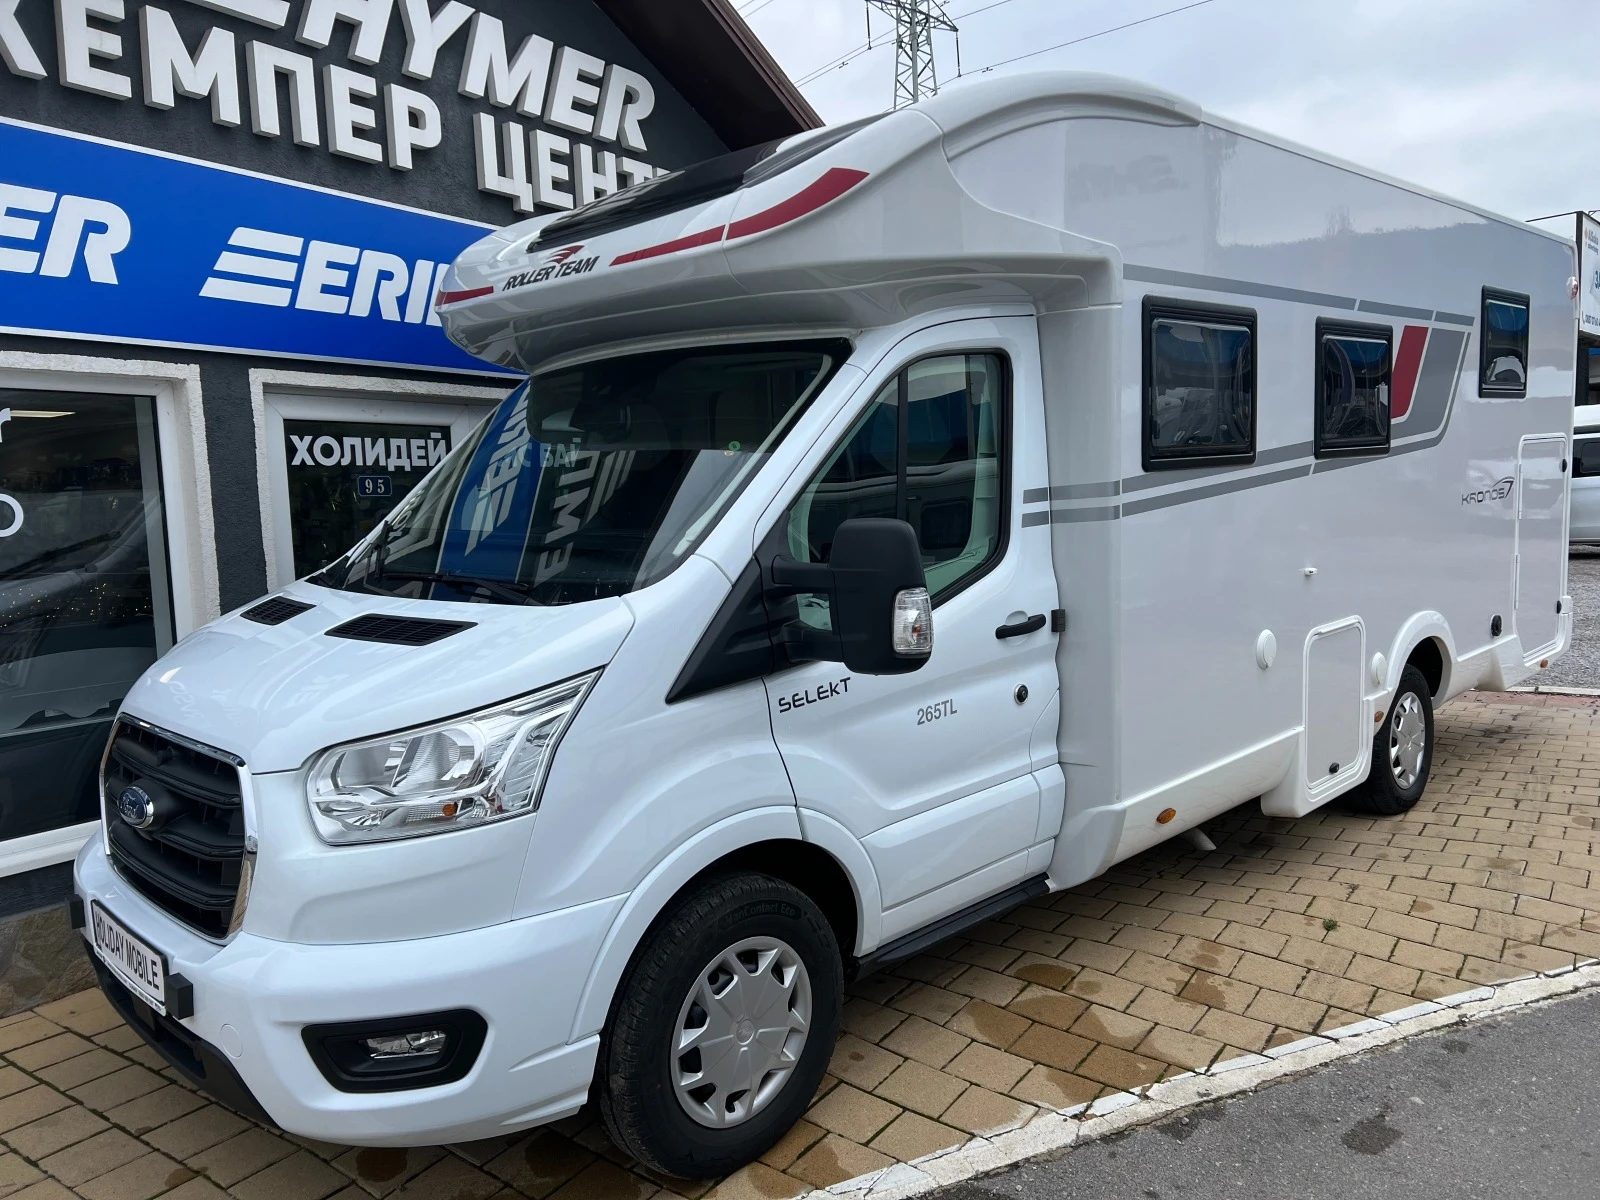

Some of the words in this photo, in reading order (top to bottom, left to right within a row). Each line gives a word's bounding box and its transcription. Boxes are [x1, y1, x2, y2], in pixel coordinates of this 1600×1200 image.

[473, 112, 670, 212] ЦЕНТ
[502, 265, 556, 291] ROLLER
[555, 256, 600, 278] TEAM
[289, 432, 447, 471] ХОЛИДЕЙ
[365, 479, 385, 493] 95
[778, 677, 851, 713] SELEKT
[917, 699, 958, 725] 265TL
[780, 903, 796, 917] Eco
[94, 910, 124, 963] HOLIDAY
[125, 938, 160, 991] MOBILE
